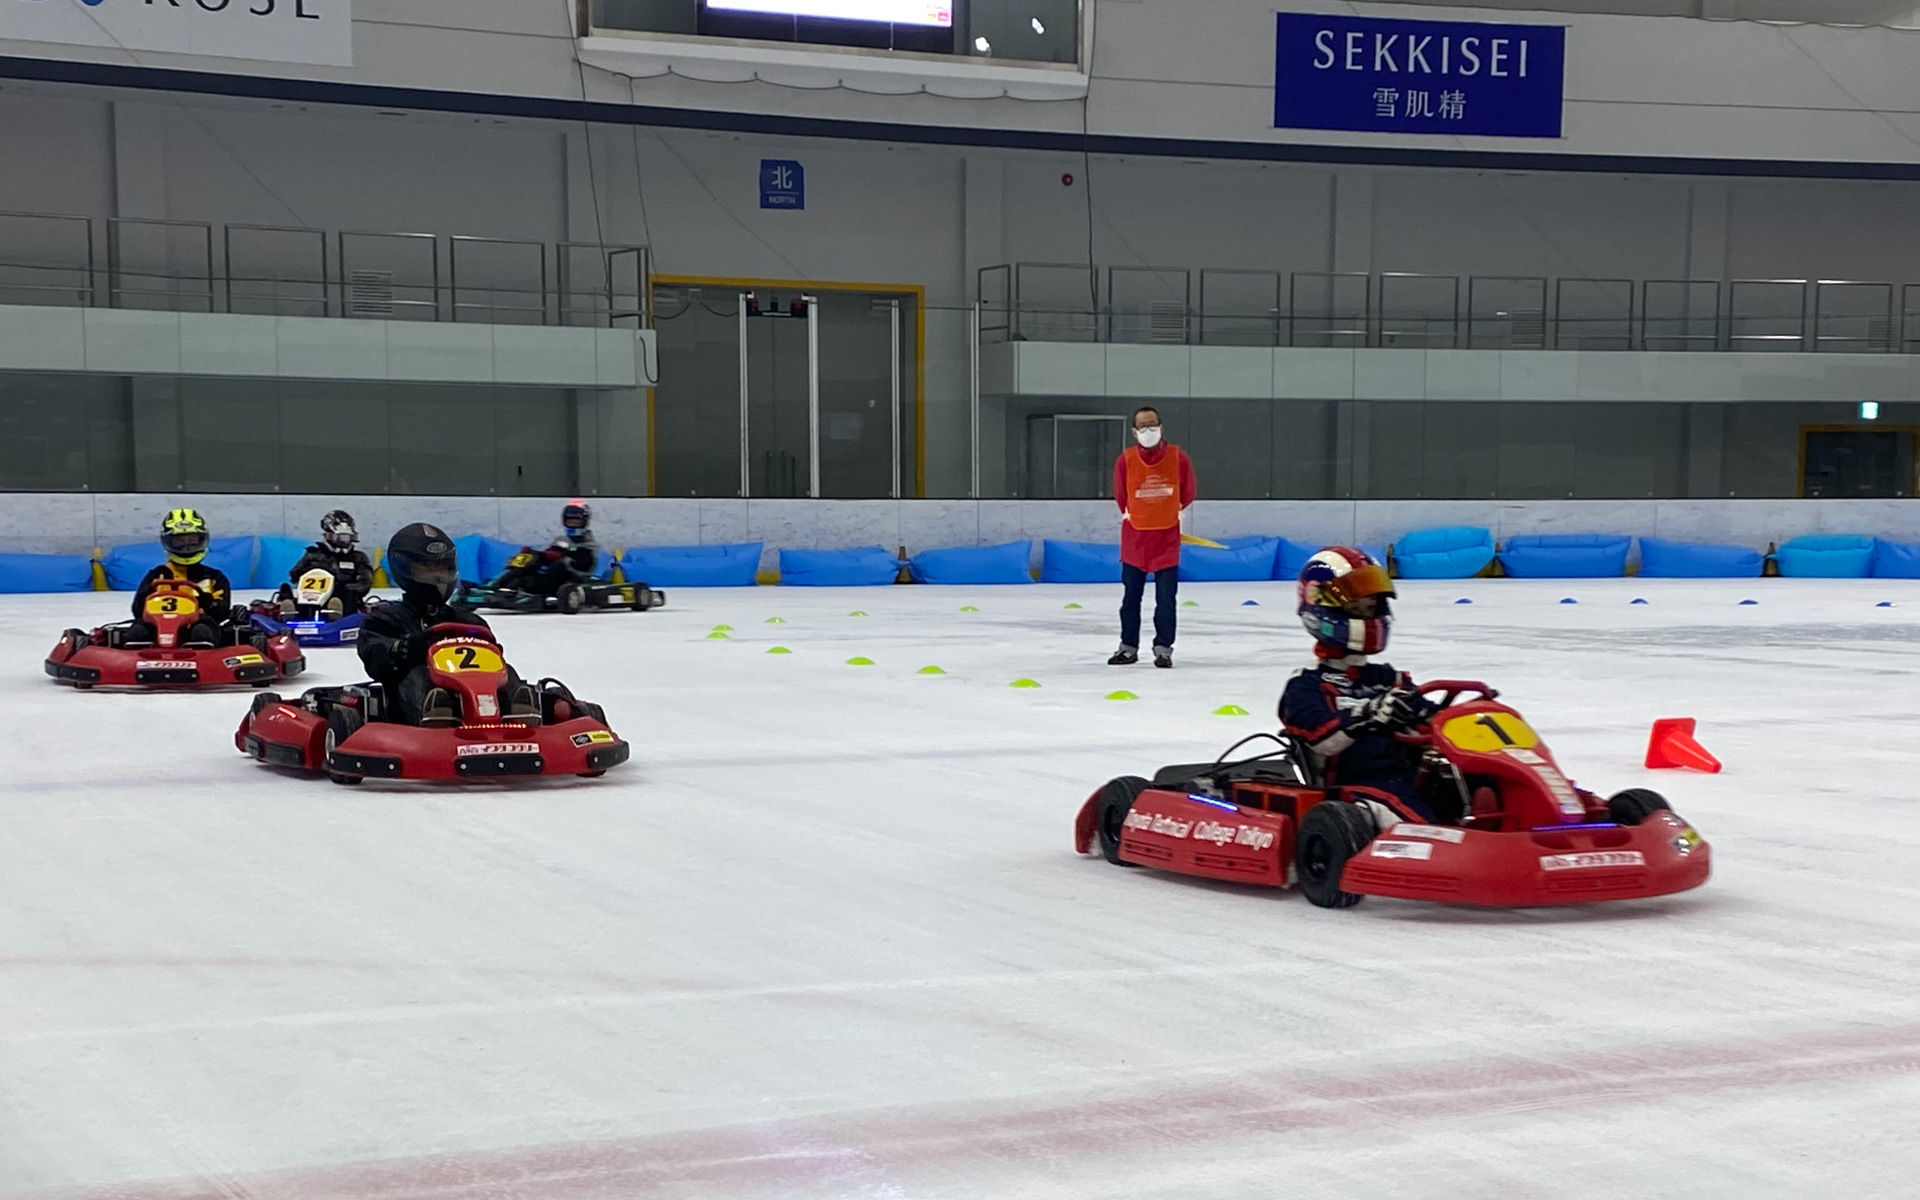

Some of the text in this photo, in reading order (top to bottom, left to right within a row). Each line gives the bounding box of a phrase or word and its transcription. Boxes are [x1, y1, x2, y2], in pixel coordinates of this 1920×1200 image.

[1313, 29, 1528, 78] SEKKISEI
[1372, 86, 1467, 120] 雪肌精
[771, 165, 793, 190] 北
[303, 578, 327, 590] 21
[161, 597, 178, 612] 3
[454, 646, 480, 669] 2
[1475, 715, 1516, 745] 1
[1193, 820, 1236, 847] College
[1234, 824, 1274, 851] Tokyo
